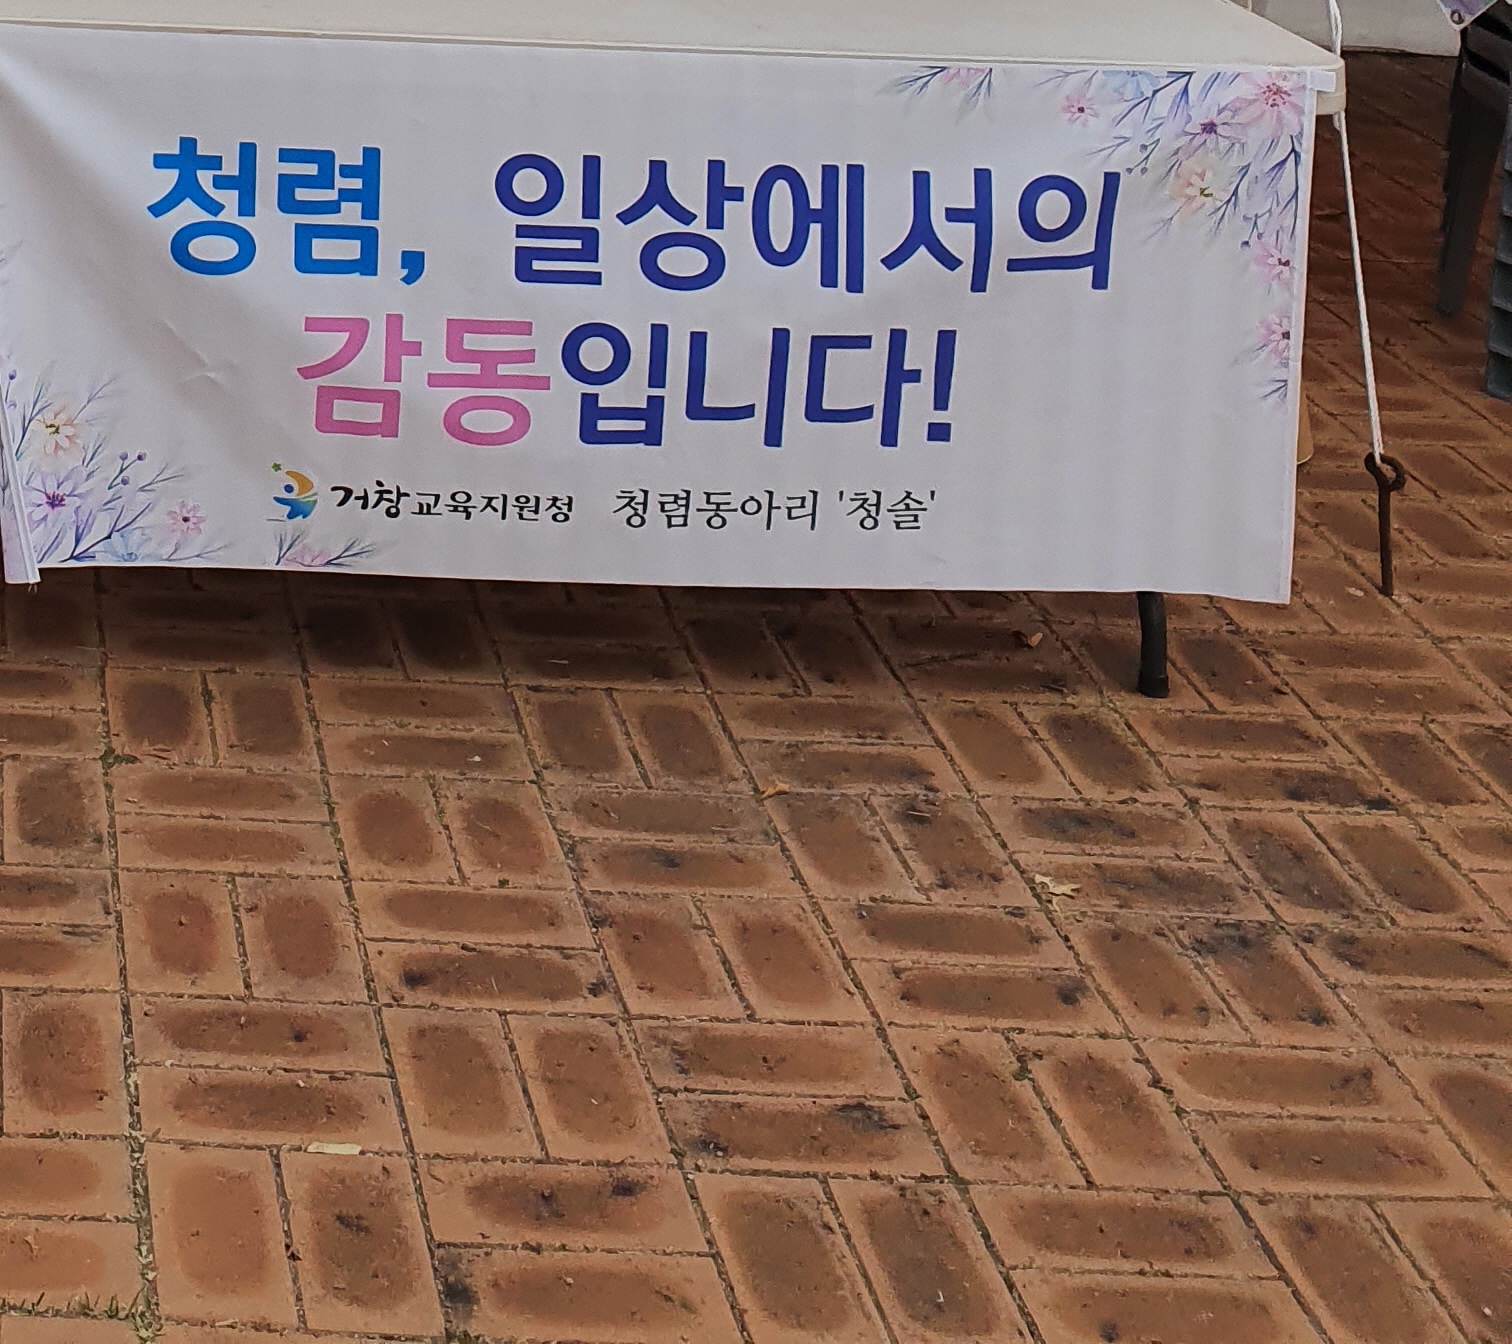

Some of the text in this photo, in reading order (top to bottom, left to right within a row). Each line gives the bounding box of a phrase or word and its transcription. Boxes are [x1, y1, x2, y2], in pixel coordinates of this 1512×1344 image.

[146, 136, 1123, 294] 청렴, 일상에서의
[295, 313, 958, 449] 감동입니다!
[330, 480, 937, 532] 거창교육지원청 청렴동아리 '청솔'
